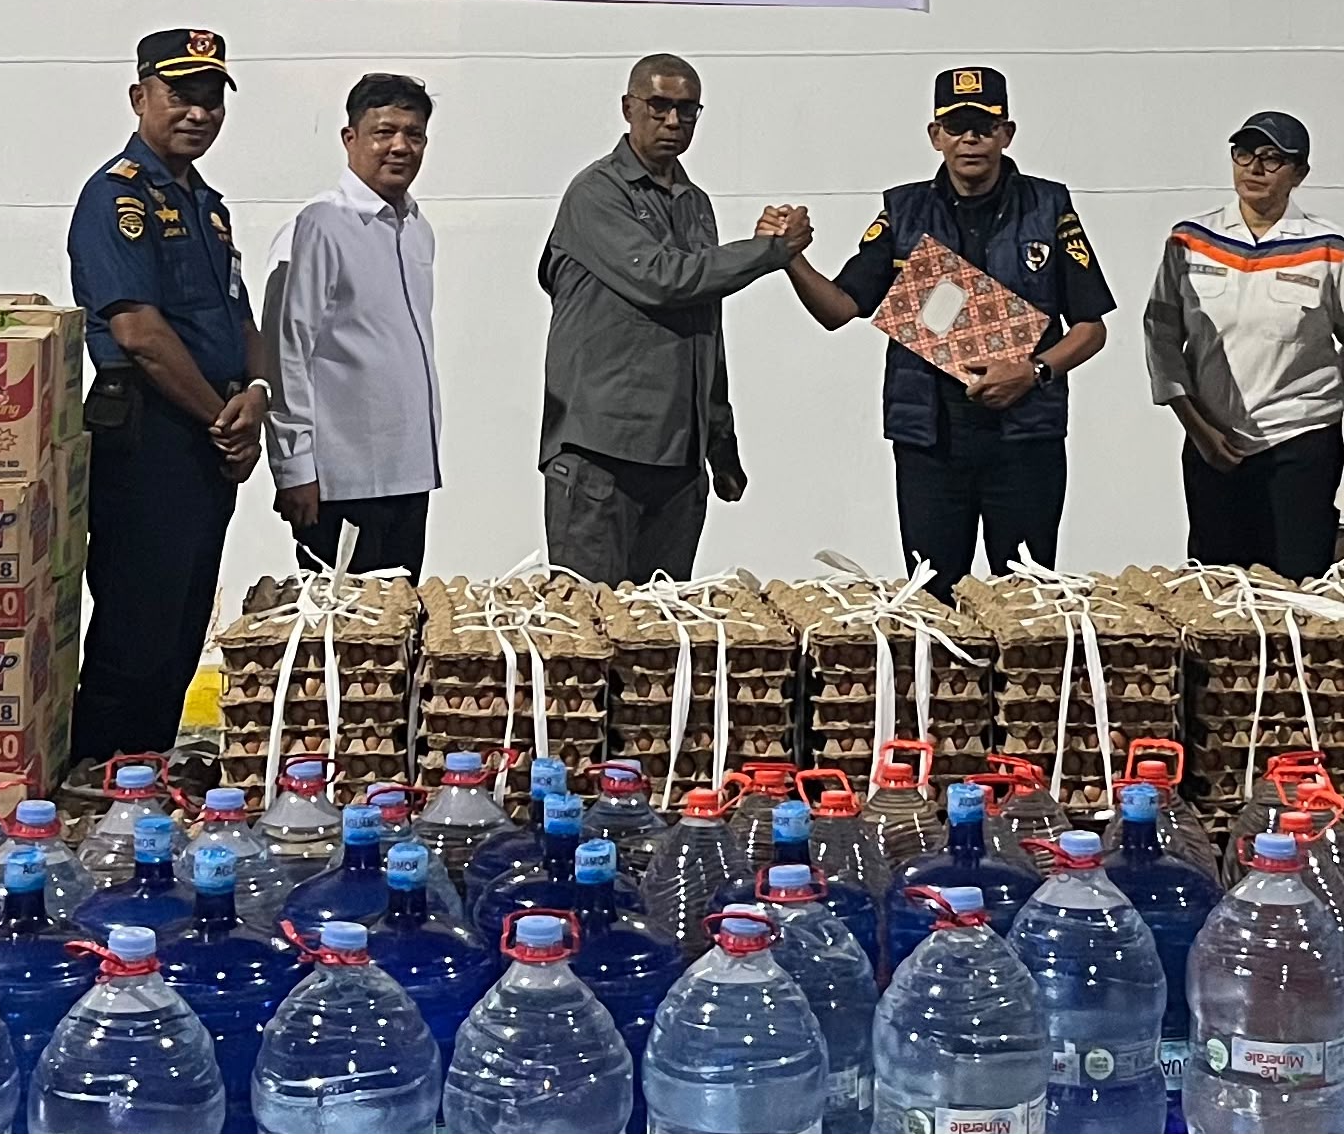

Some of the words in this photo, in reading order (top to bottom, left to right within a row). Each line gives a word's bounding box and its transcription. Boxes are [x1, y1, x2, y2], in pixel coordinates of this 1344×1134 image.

[0, 561, 13, 577] 8
[0, 705, 14, 720] 8
[1244, 1050, 1305, 1069] Minerale
[1261, 1065, 1279, 1082] Le
[950, 1120, 1012, 1134] Minerale
